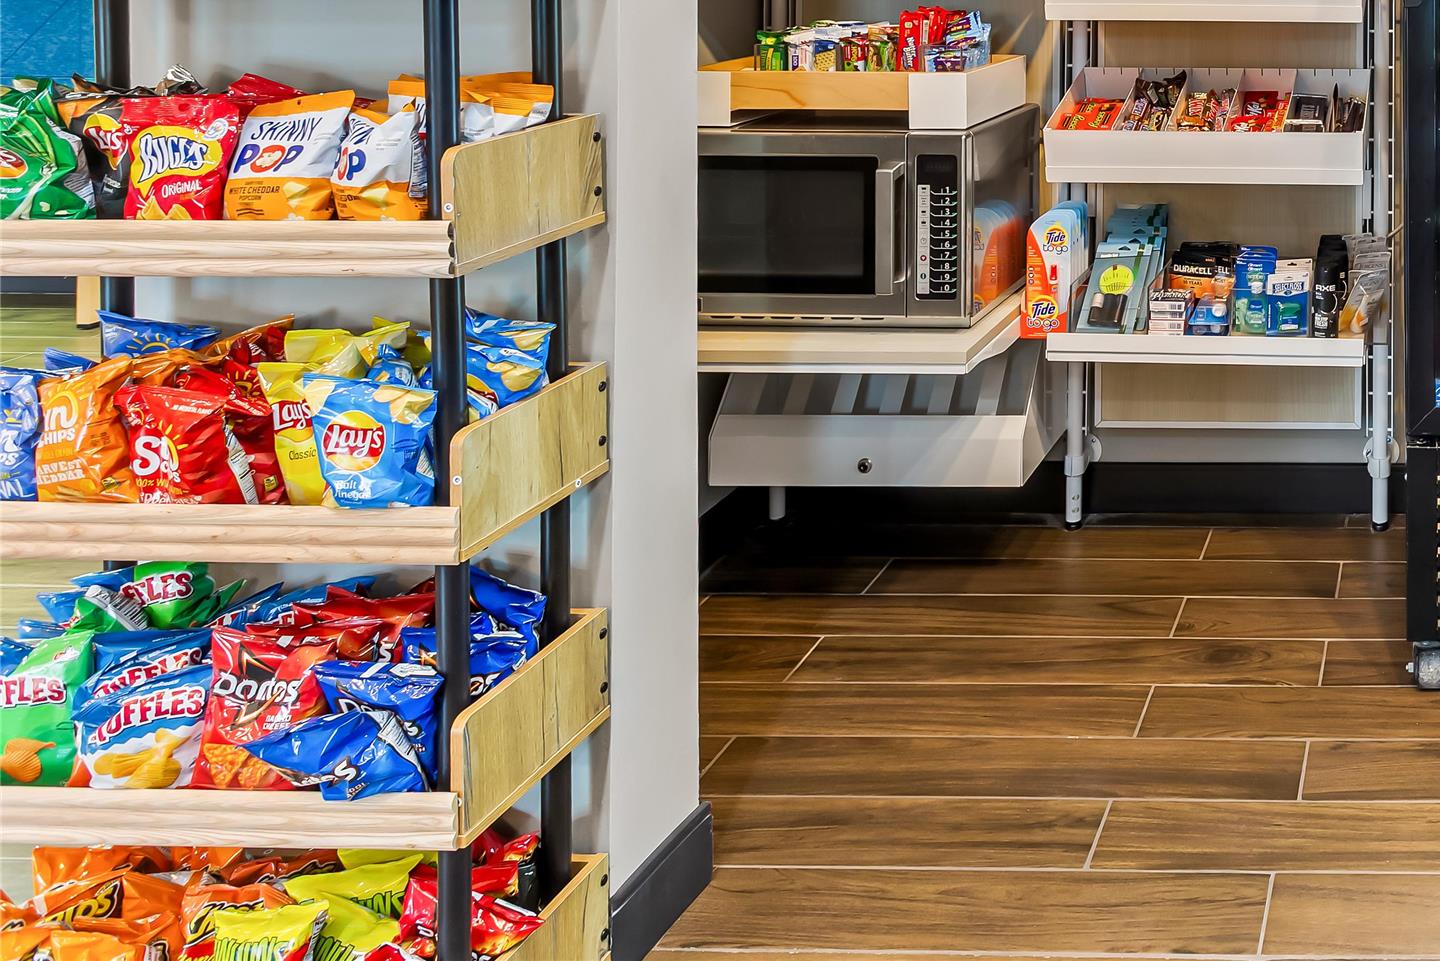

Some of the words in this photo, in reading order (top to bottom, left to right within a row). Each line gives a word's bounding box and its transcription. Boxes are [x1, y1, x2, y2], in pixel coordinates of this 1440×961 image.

[252, 117, 323, 141] SKINNY
[233, 144, 304, 174] POP
[161, 180, 203, 198] ORIGINAL
[248, 186, 280, 194] CHEDDAR
[1046, 232, 1066, 243] Tide
[1173, 265, 1212, 275] DURACELL
[1032, 303, 1056, 316] Tide
[1027, 317, 1040, 327] to
[1043, 318, 1060, 333] go
[326, 426, 383, 457] Lay's
[289, 448, 317, 461] Classic
[213, 671, 300, 703] Doritos
